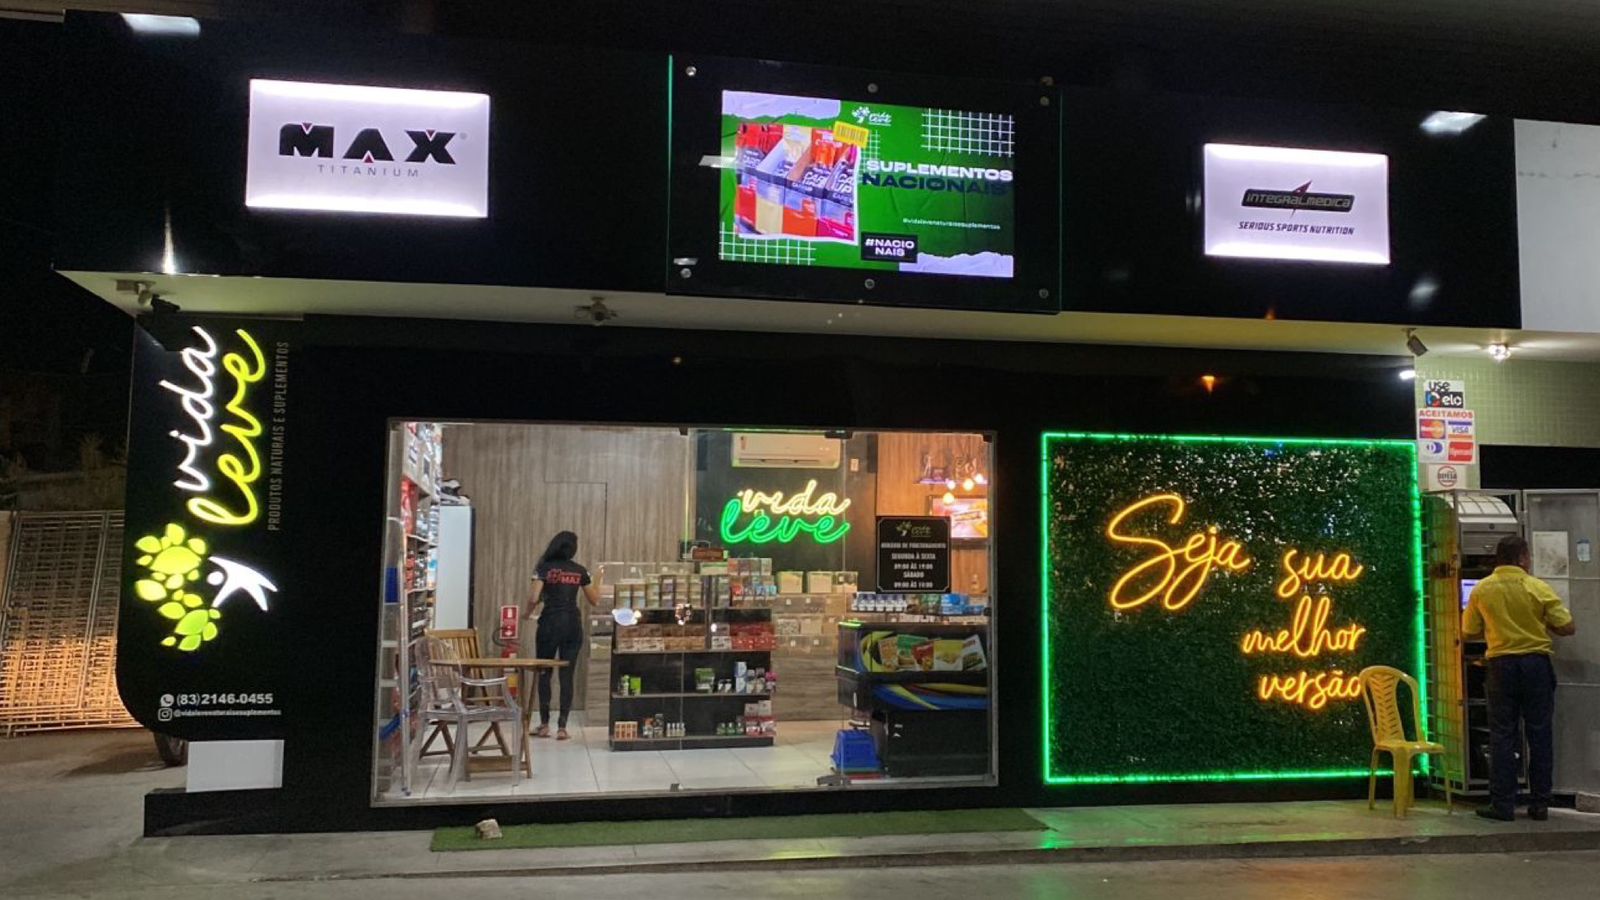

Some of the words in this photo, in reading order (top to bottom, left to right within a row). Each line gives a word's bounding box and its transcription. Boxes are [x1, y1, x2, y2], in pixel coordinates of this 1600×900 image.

[279, 122, 456, 165] MAX
[317, 164, 419, 178] TITANIUM
[861, 172, 1011, 197] NACIONAIS
[866, 159, 1013, 182] SUPLEMENTOS
[864, 237, 915, 249] #NACIO
[1238, 221, 1275, 231] SERIOUS
[1275, 223, 1308, 233] SPORTS
[1309, 226, 1355, 236] NUTRITION
[874, 247, 906, 257] NAIS
[273, 341, 289, 415] SUPLEMENTOS
[158, 325, 218, 491] vida
[1419, 410, 1473, 419] ACEITAMOS
[1441, 393, 1462, 406] elo
[186, 328, 266, 525] leve
[1451, 426, 1469, 434] VISA
[270, 425, 286, 475] NATURAIS
[267, 477, 283, 531] PRODUTOS
[737, 479, 851, 516] vida
[720, 498, 851, 544] leve
[1108, 494, 1251, 610] Seja
[1278, 549, 1364, 598] sua
[1242, 596, 1366, 656] melhor
[1258, 669, 1361, 709] versão
